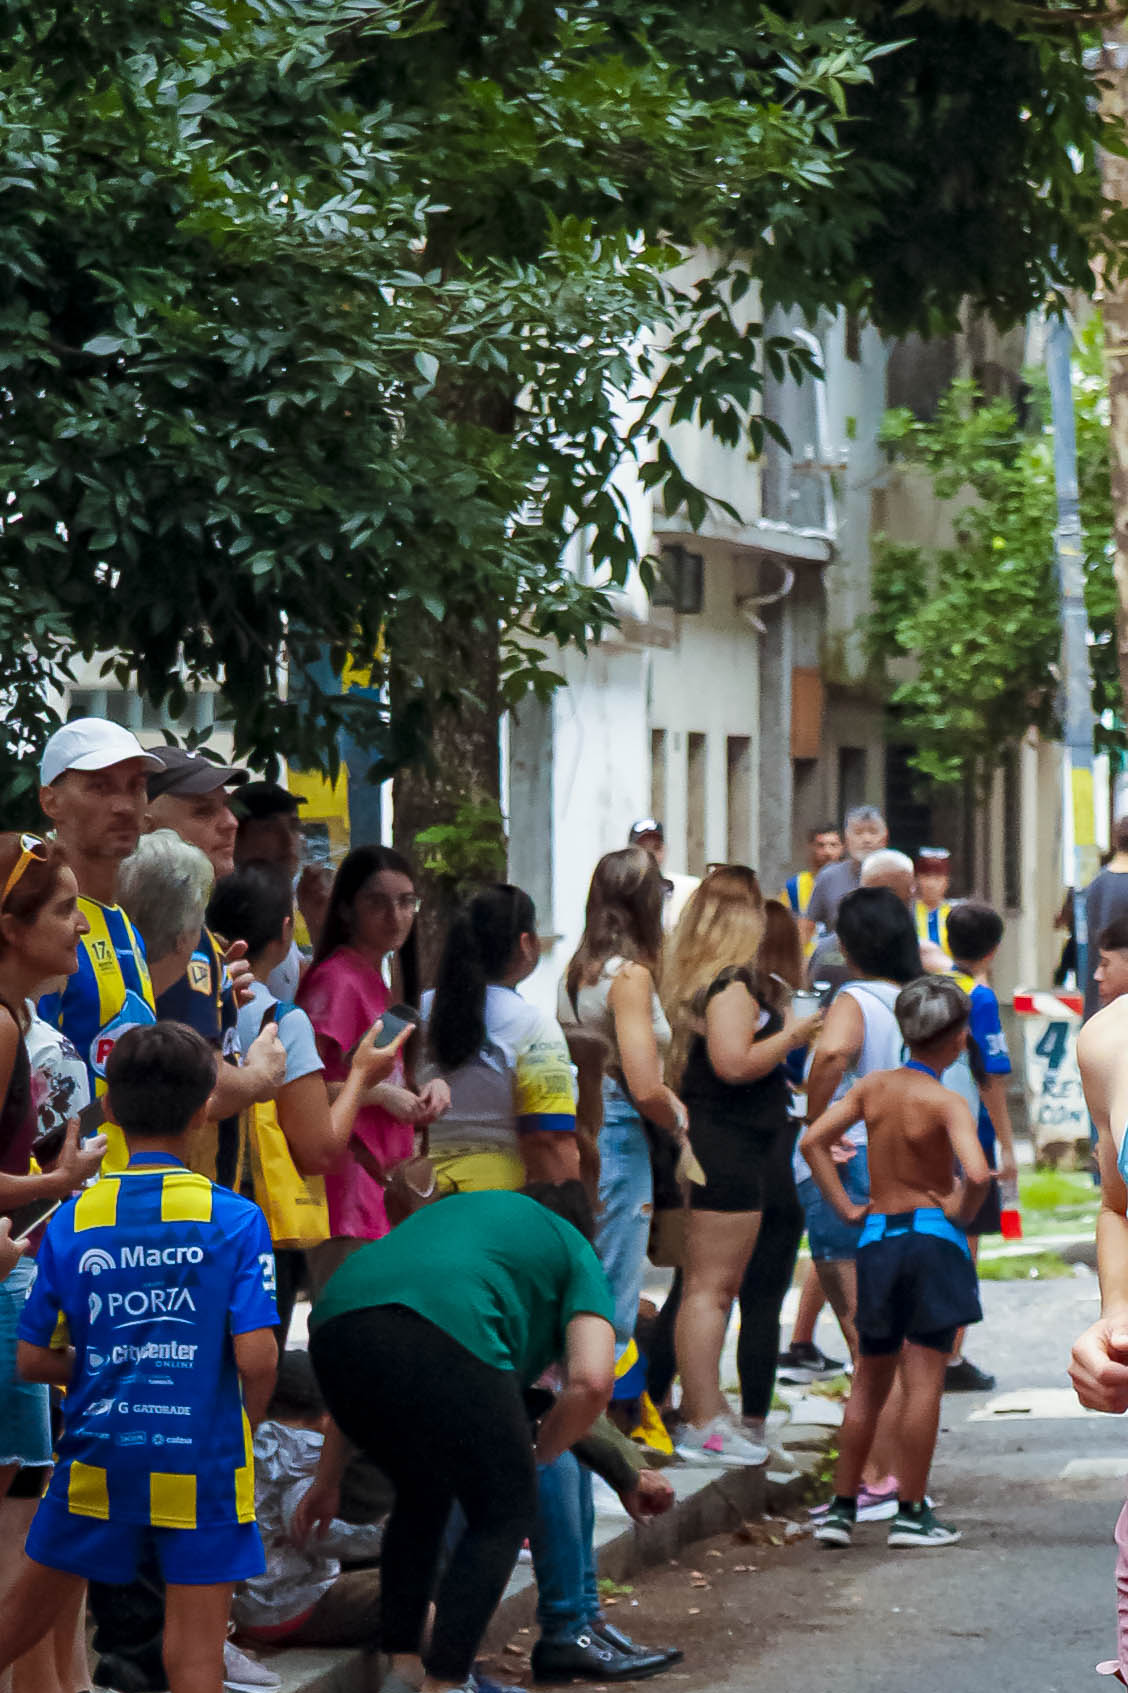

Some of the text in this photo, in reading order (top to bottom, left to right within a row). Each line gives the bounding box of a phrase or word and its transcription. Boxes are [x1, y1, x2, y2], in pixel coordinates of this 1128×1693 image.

[1036, 1021, 1069, 1069] 4
[120, 1245, 204, 1269] Macro
[108, 1287, 197, 1317] PORTA
[132, 1404, 191, 1416] GATORADE
